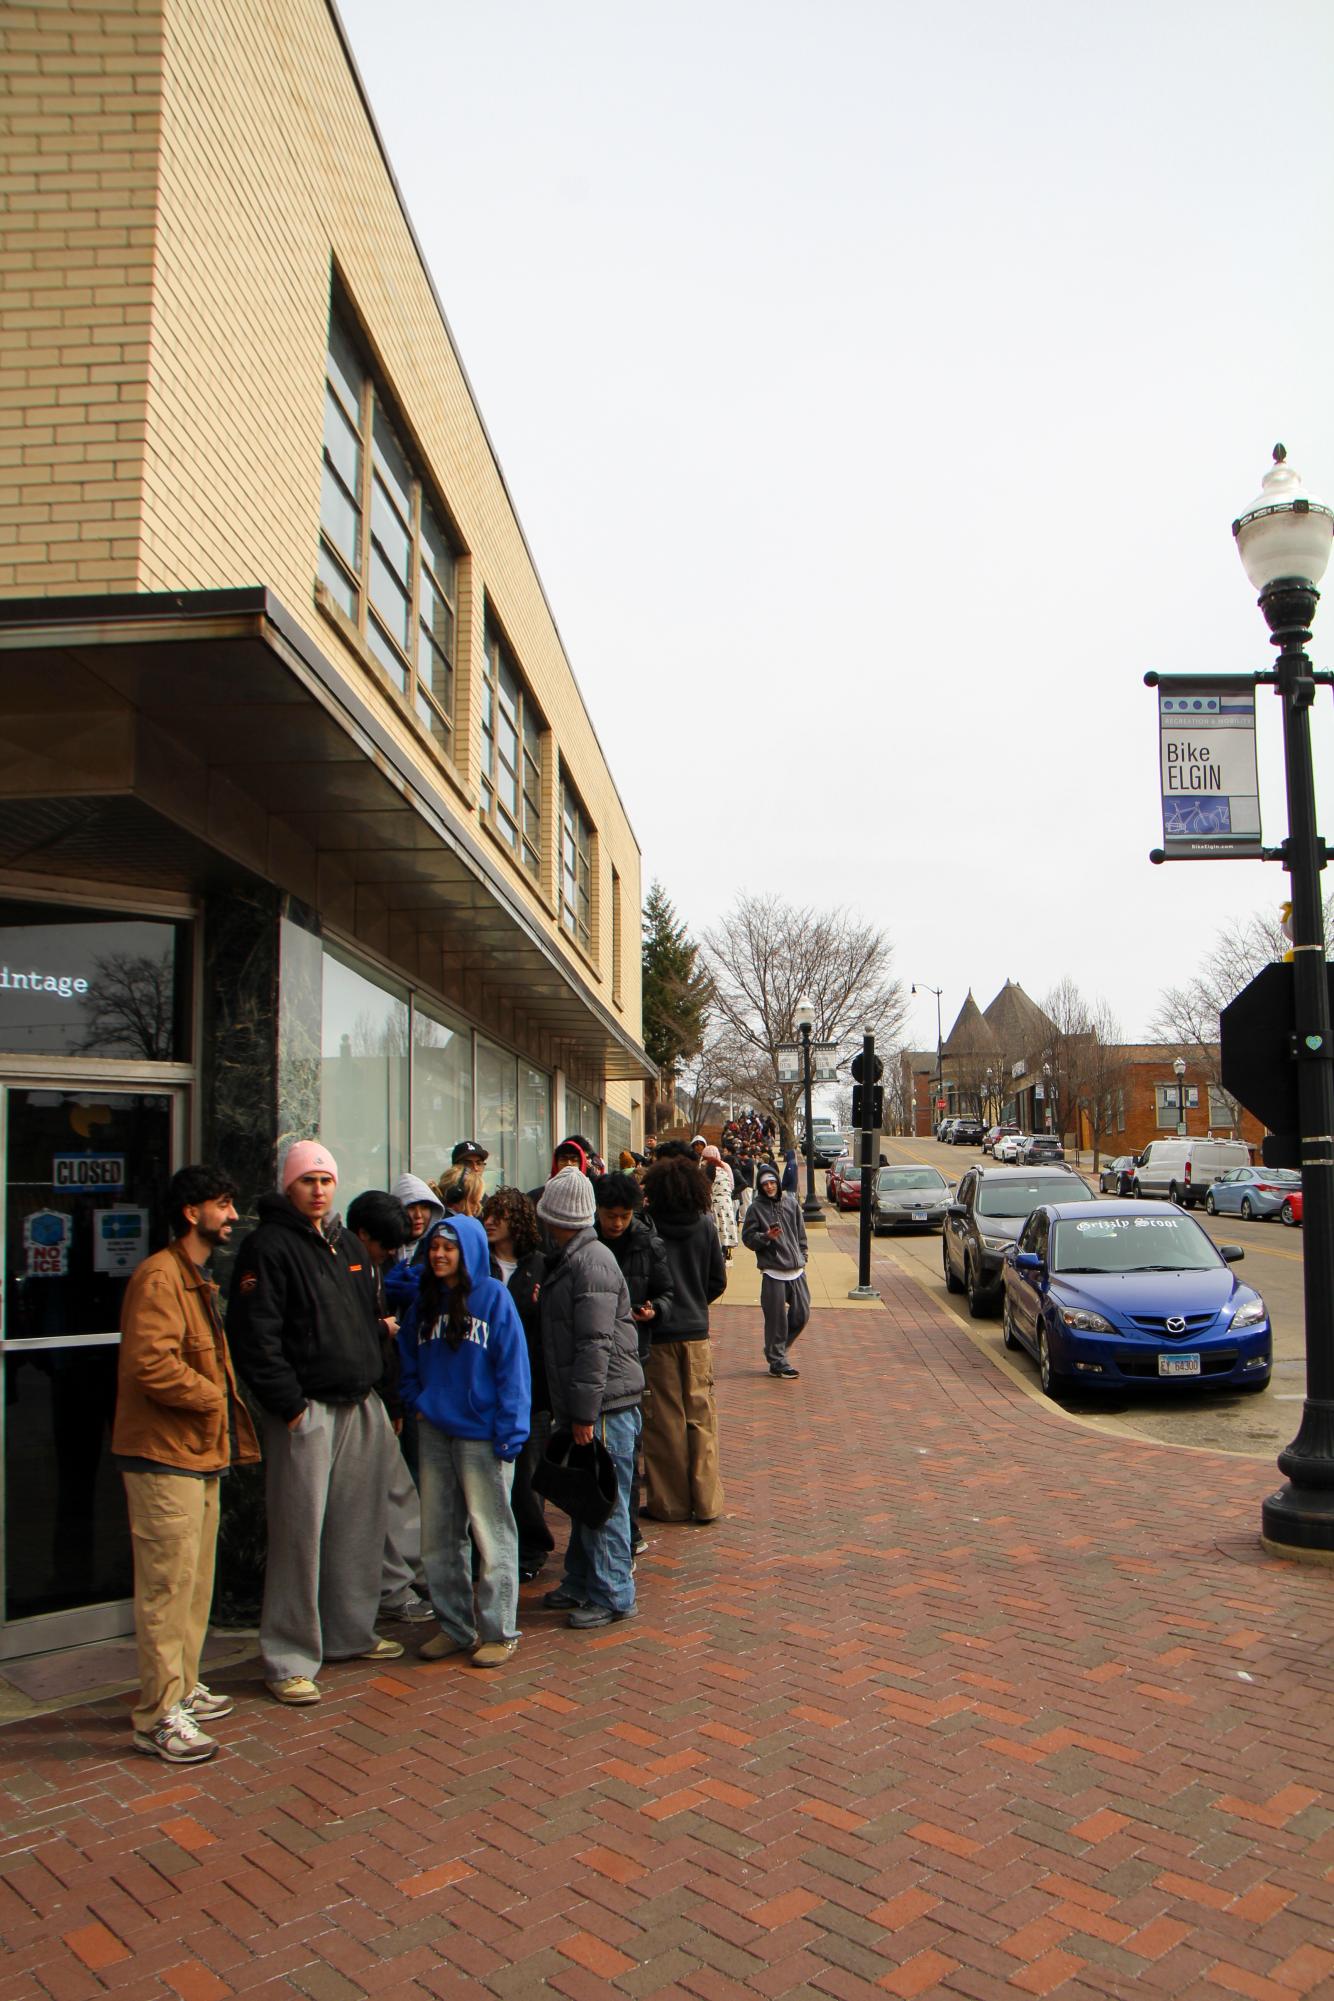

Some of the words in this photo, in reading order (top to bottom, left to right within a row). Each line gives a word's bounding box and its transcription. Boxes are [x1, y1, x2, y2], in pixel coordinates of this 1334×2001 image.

[1167, 742, 1210, 762] Bike
[1168, 765, 1221, 790] ELGIN
[0, 966, 88, 997] intage
[57, 1161, 121, 1184] CLOSED
[1076, 1218, 1130, 1231] Grizzly
[34, 1247, 61, 1259] NO
[34, 1260, 61, 1273] ICE
[418, 1313, 490, 1350] NTKY
